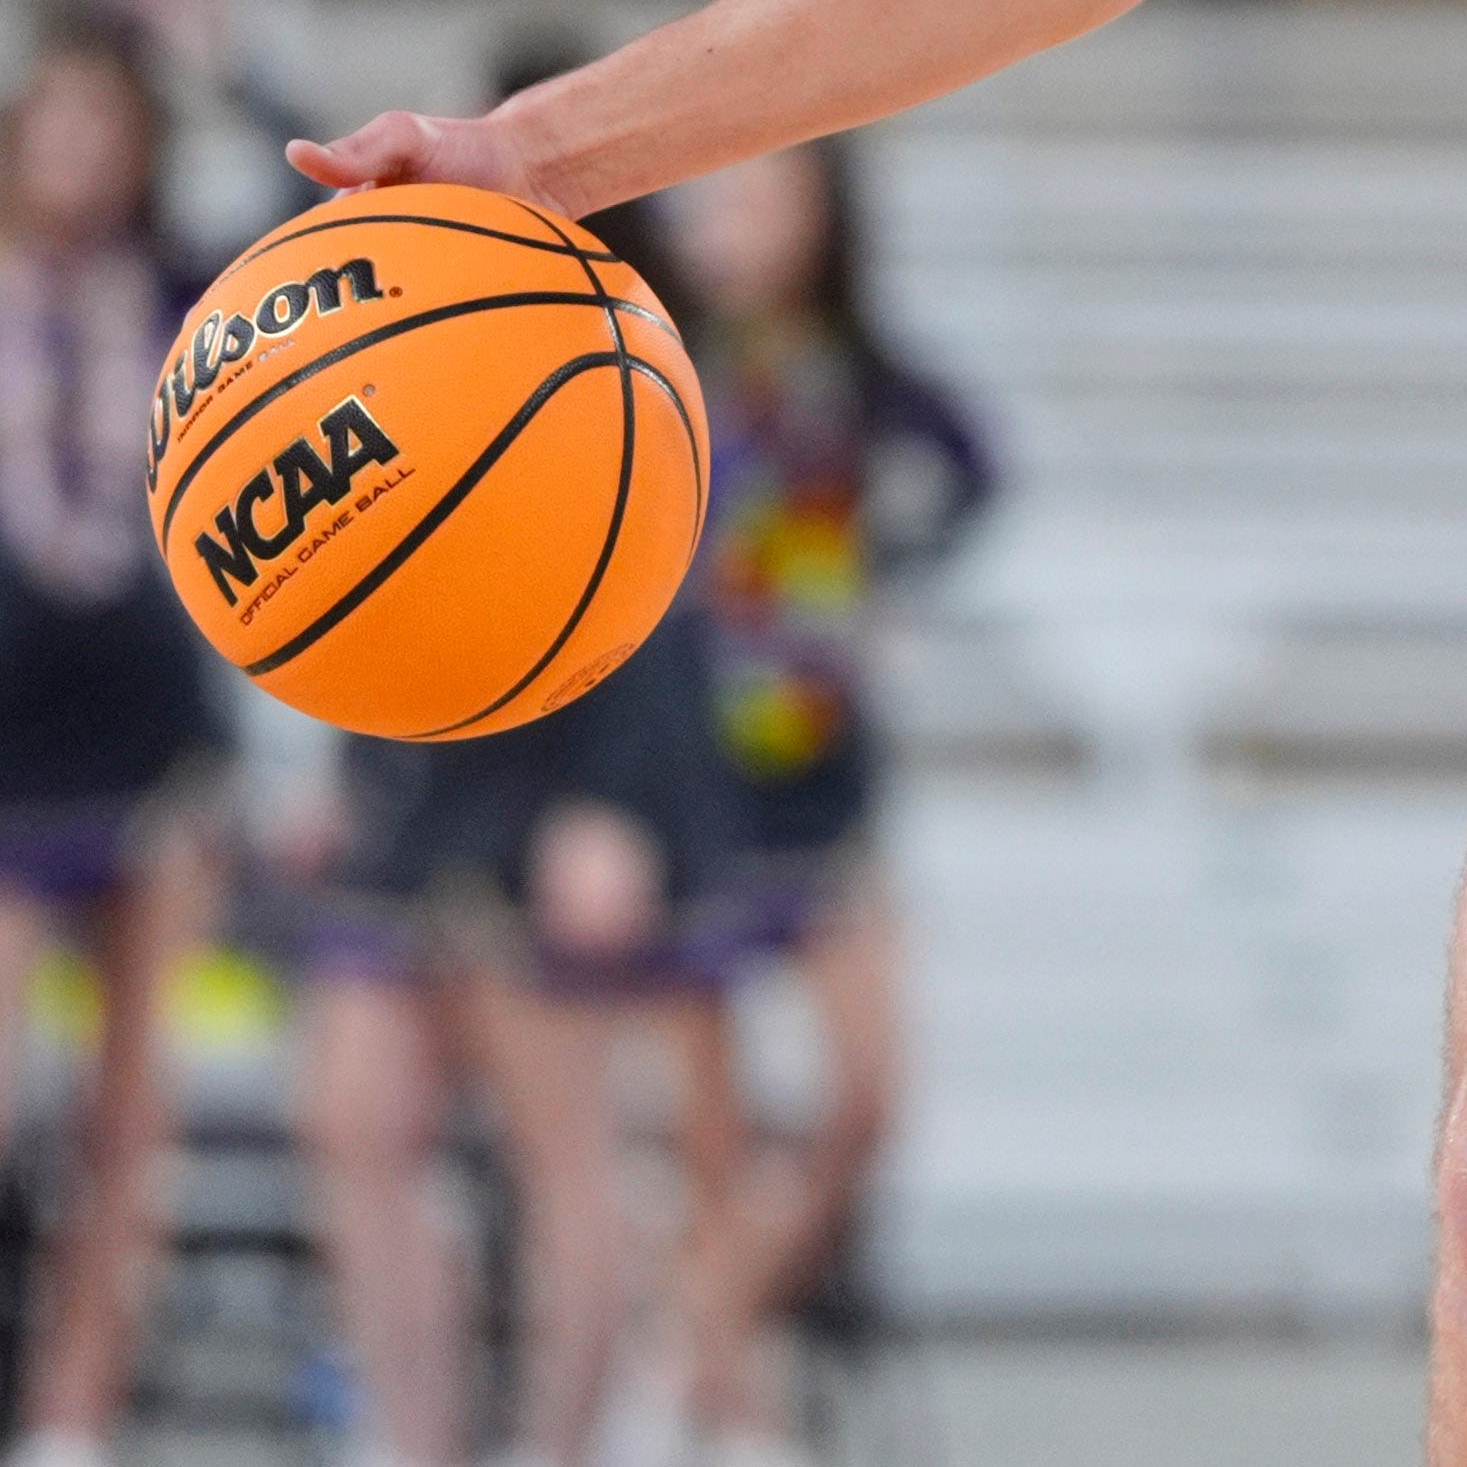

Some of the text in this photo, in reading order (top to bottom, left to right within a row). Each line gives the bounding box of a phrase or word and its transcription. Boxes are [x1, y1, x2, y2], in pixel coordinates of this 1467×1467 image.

[177, 395, 214, 444] INDOOR
[217, 360, 254, 395] GAME
[193, 393, 401, 609] NCAA
[239, 467, 417, 627] OFFICIAL GAME BALL
